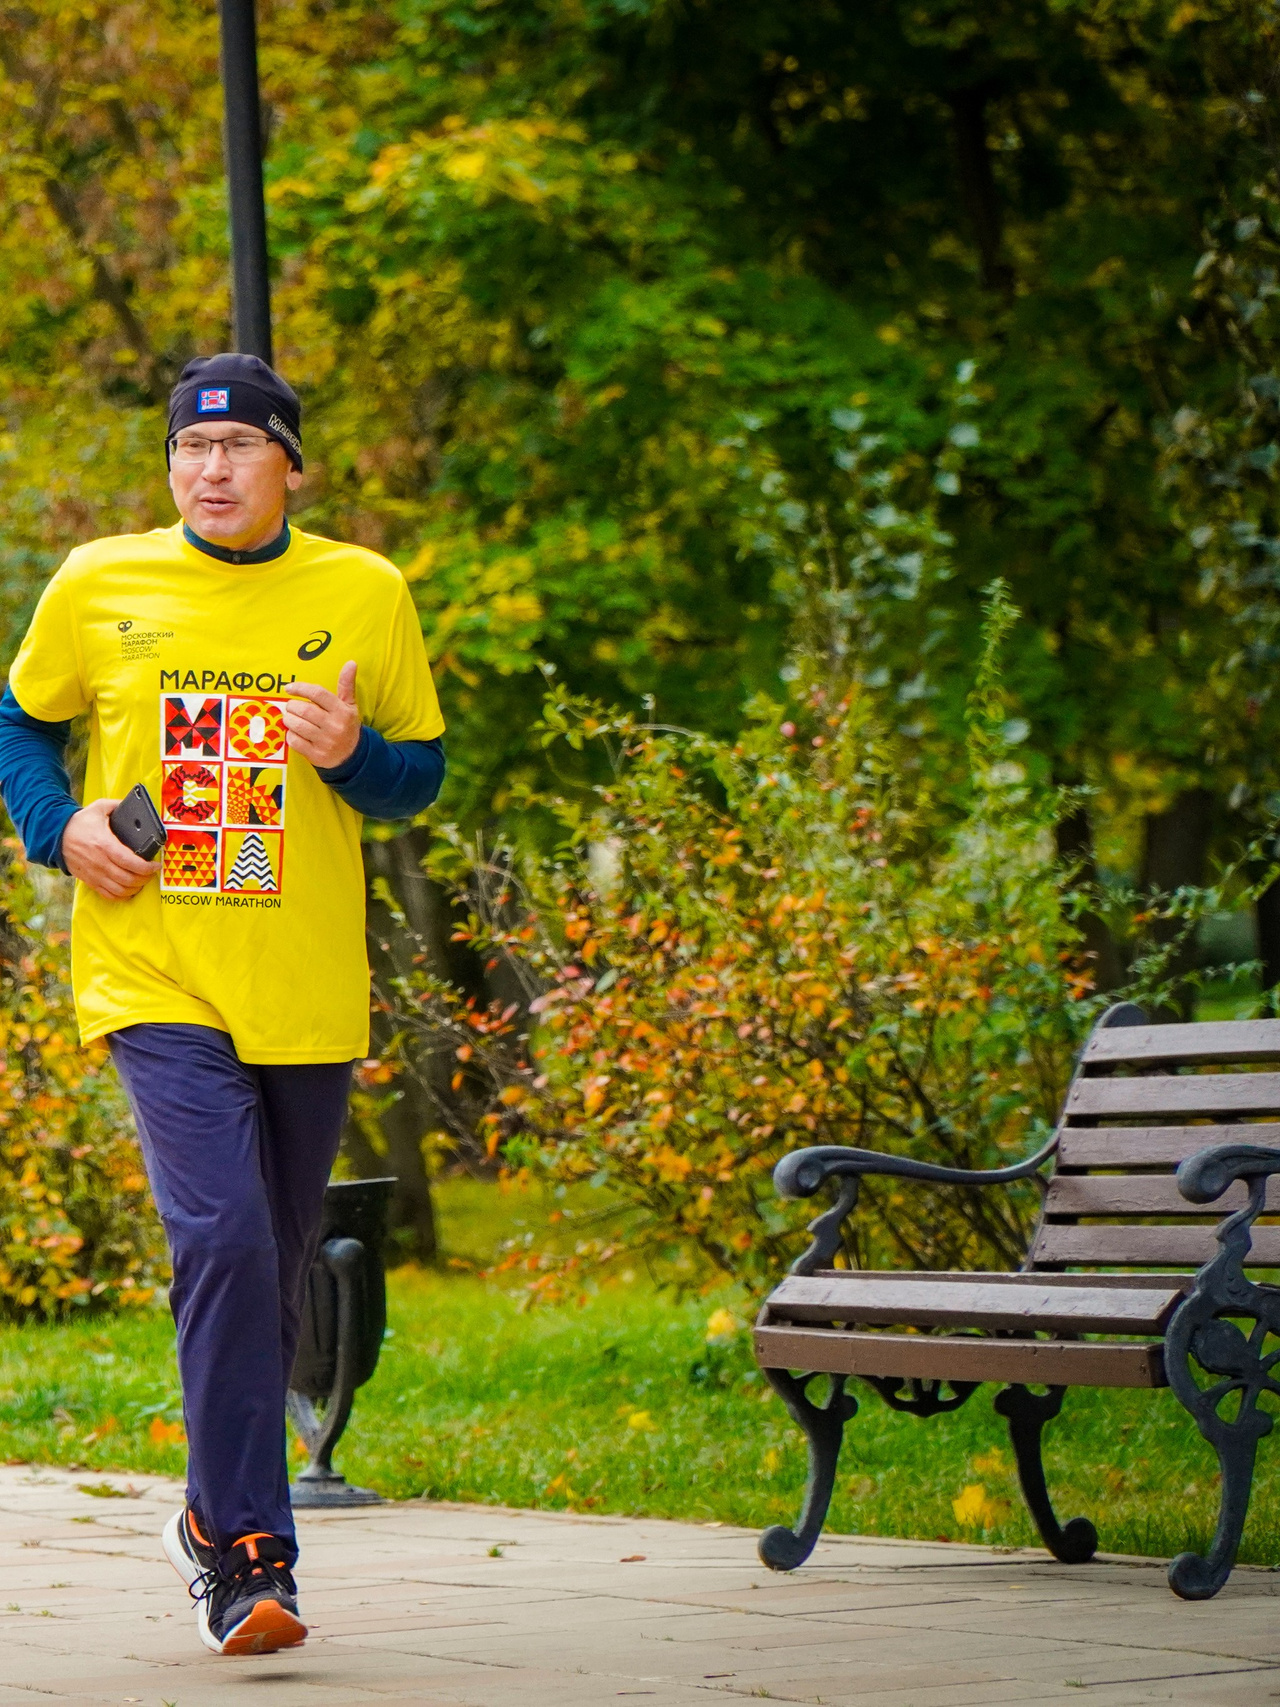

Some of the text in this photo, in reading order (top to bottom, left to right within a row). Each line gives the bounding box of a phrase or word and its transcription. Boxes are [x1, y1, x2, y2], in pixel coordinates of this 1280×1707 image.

[121, 631, 174, 641] МОСКОВСКИЙ
[122, 639, 158, 649] МАРАФОН
[122, 646, 153, 655] MOSCOW
[122, 653, 160, 662] MARATHON
[160, 669, 296, 694] МАРАФОН
[160, 894, 282, 908] MOSCOW MARATHON
